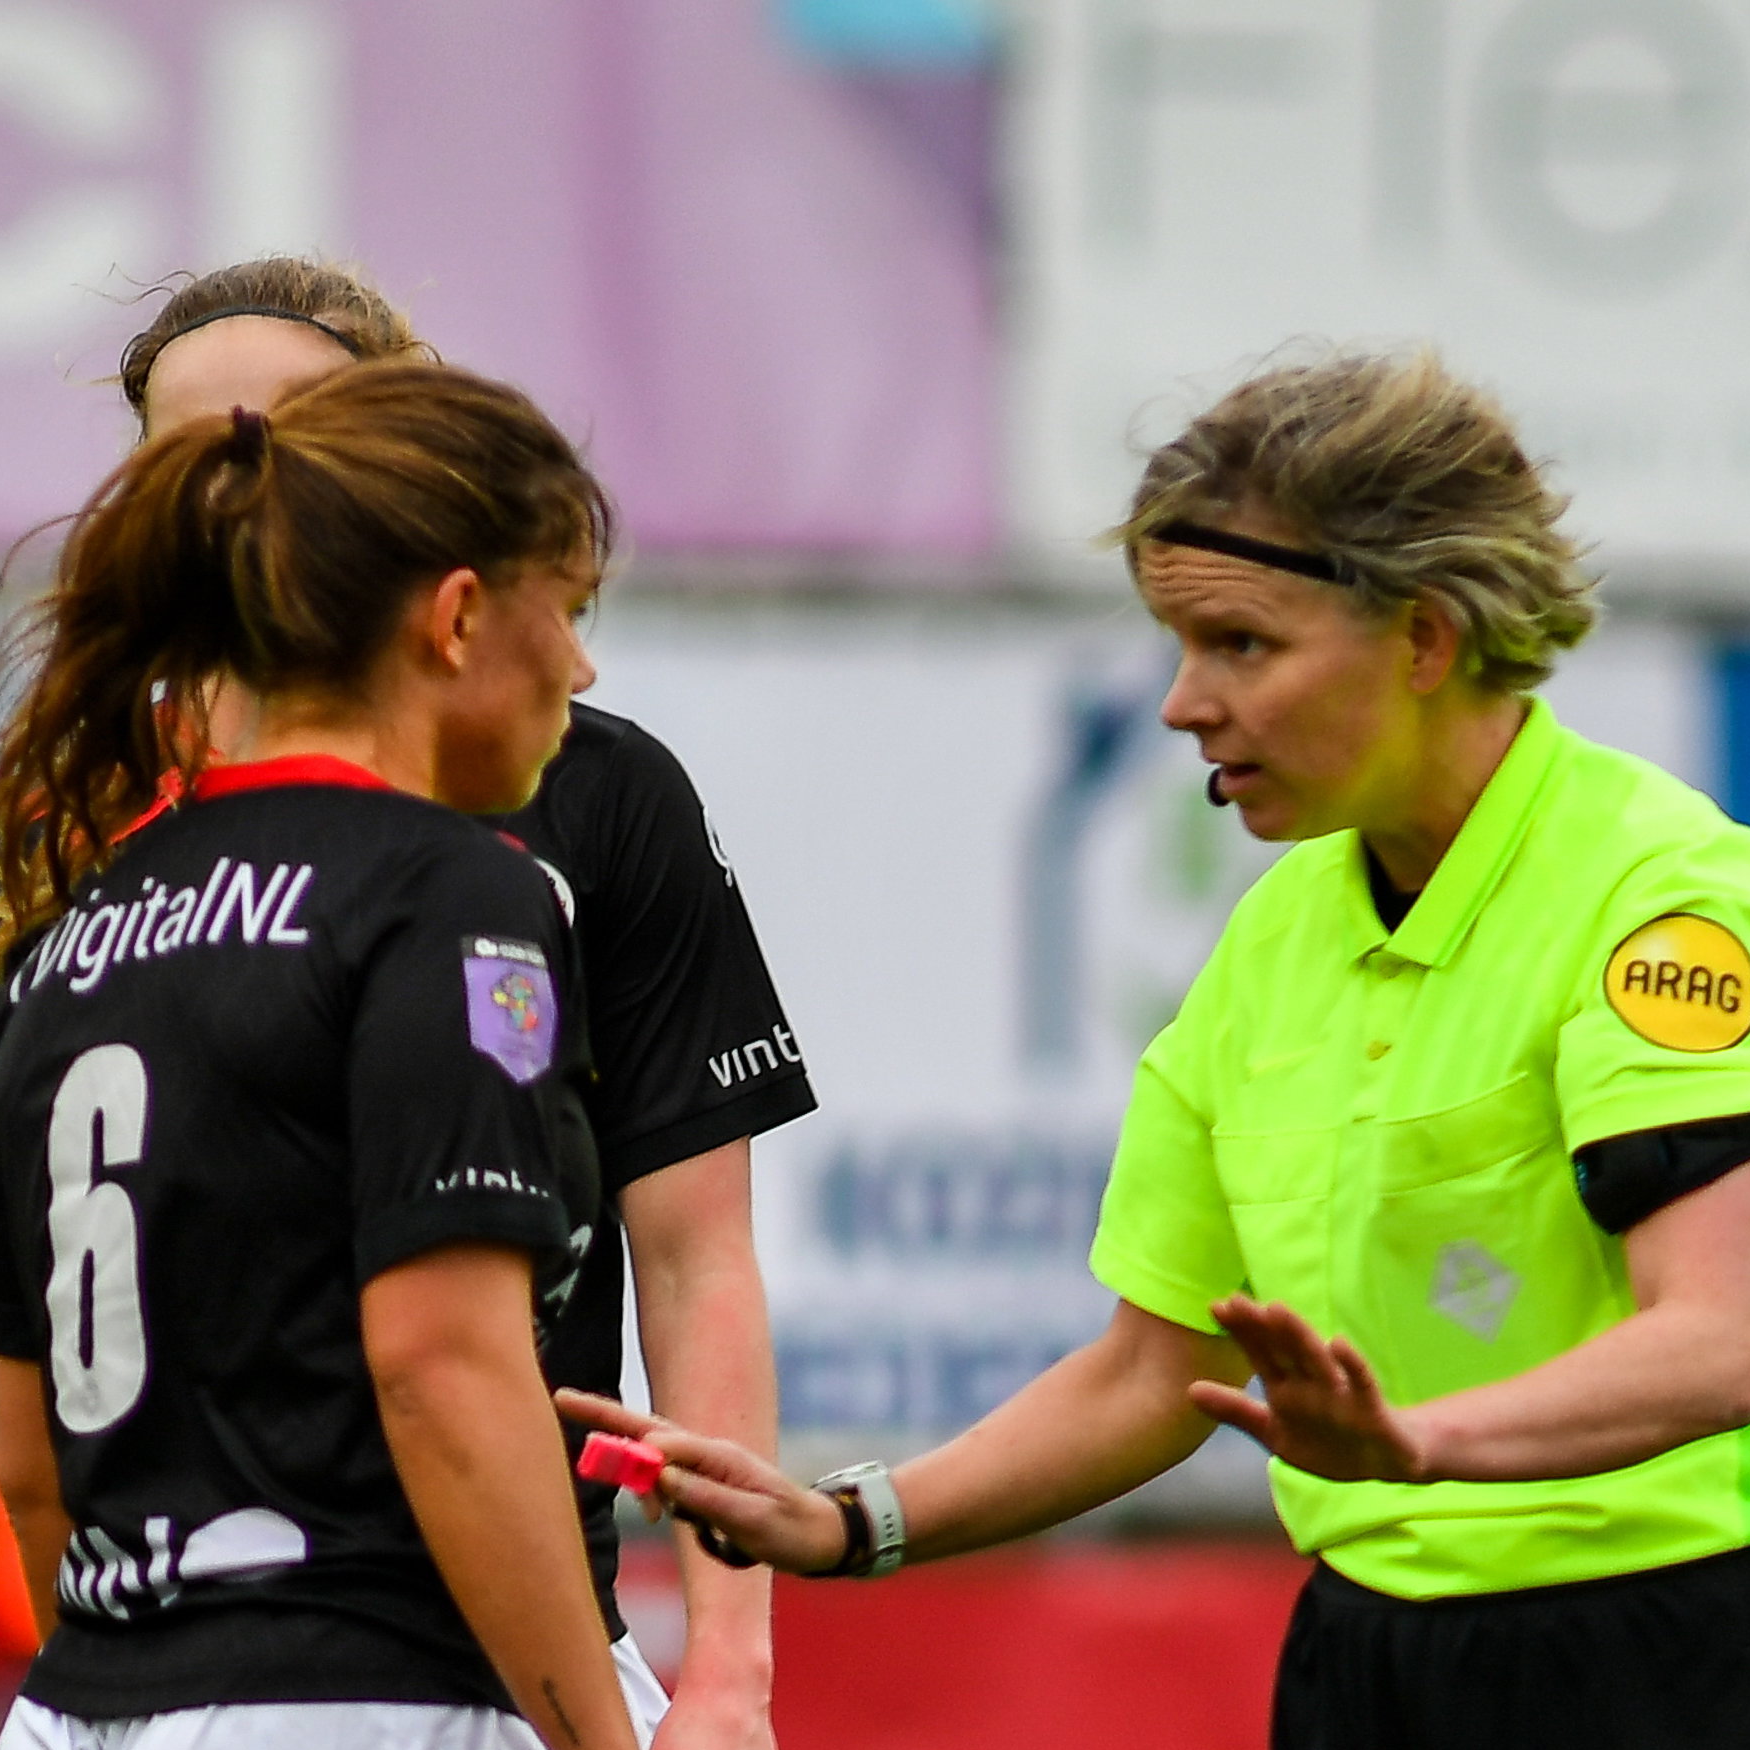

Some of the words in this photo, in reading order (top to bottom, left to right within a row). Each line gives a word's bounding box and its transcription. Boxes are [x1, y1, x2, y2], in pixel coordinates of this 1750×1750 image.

[1623, 960, 1742, 1013] ARAG
[708, 1023, 801, 1087] vint
[47, 1043, 149, 1434] 6
